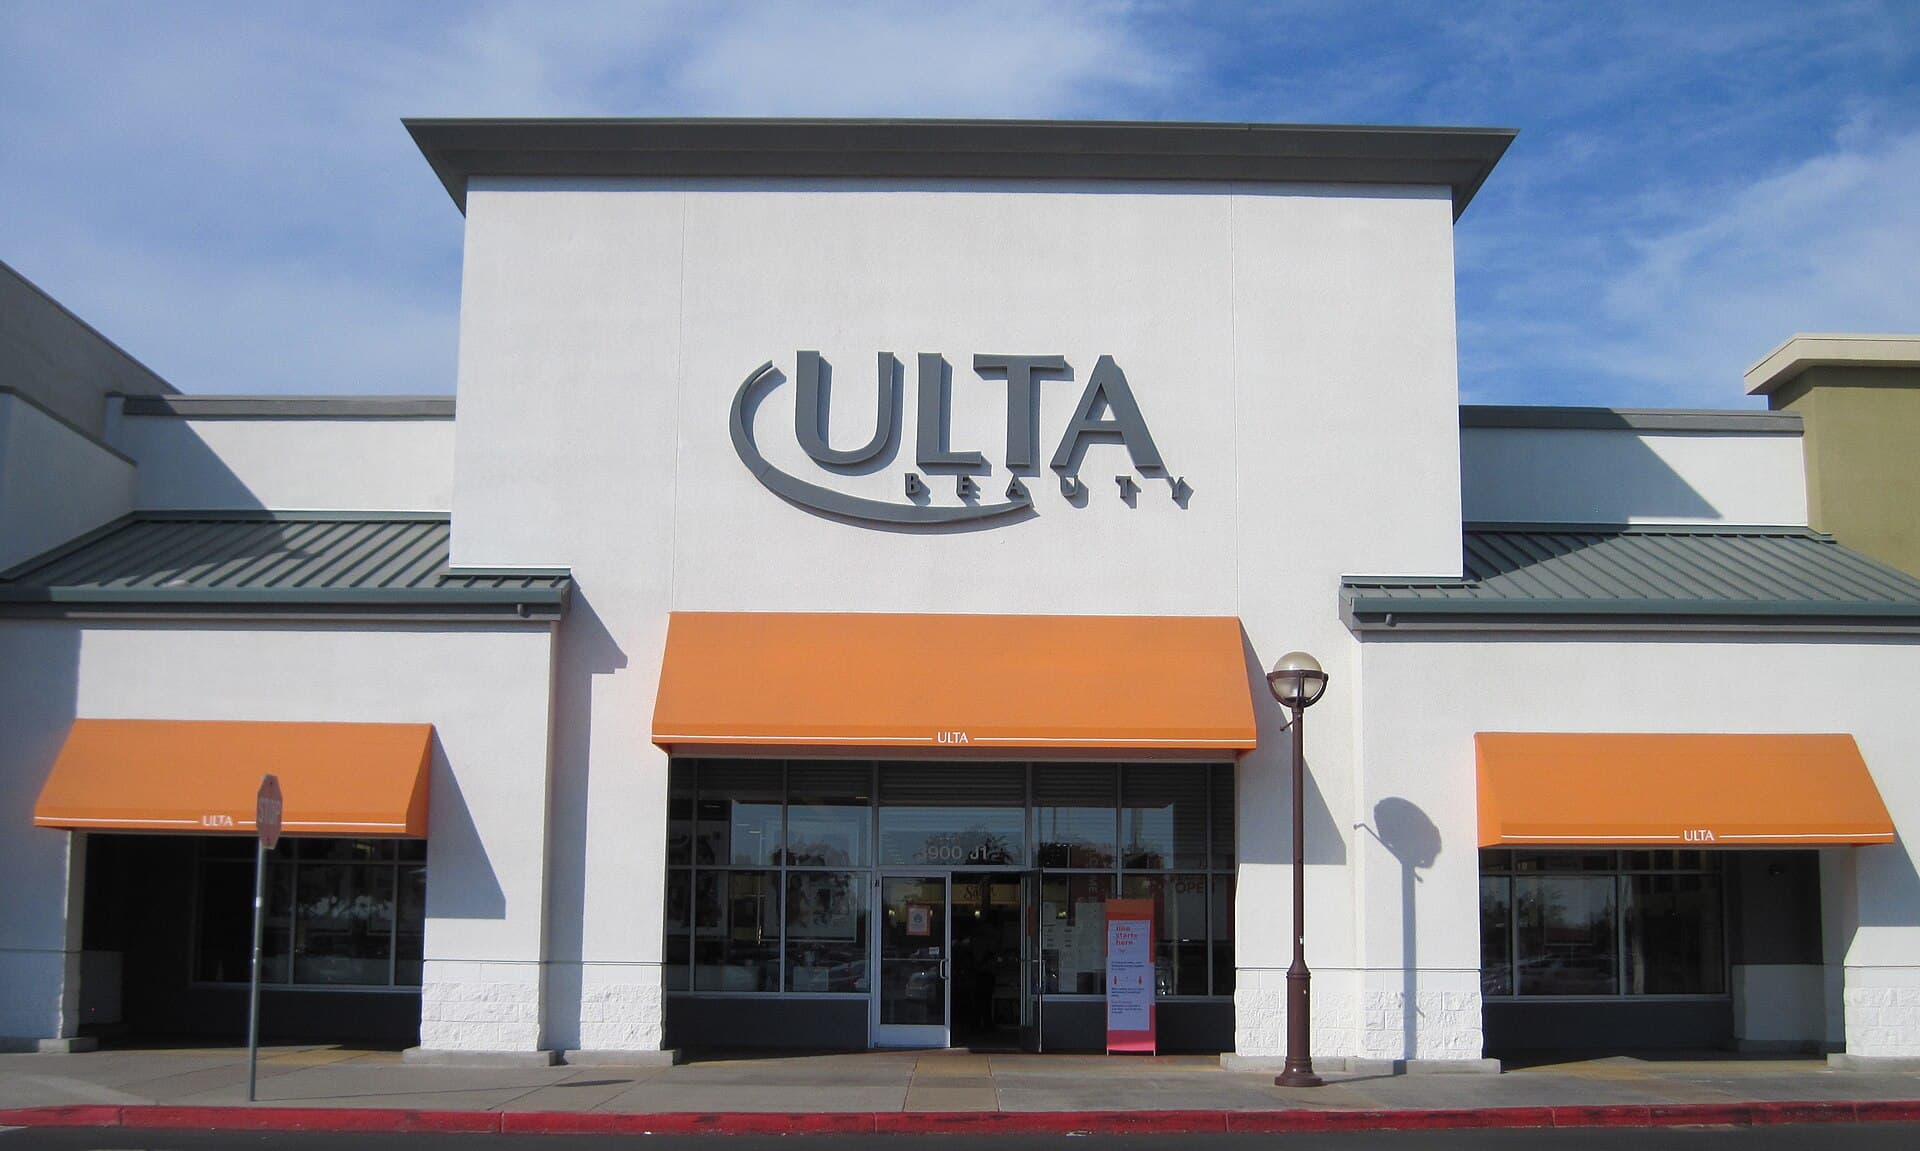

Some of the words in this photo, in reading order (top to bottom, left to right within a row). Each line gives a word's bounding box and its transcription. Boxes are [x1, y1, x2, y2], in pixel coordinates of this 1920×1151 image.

[796, 351, 1160, 468] ULTA
[904, 472, 1189, 500] BEAUTY
[937, 731, 969, 744] ULTA
[202, 815, 233, 826] ULTA
[1684, 829, 1715, 841] ULTA
